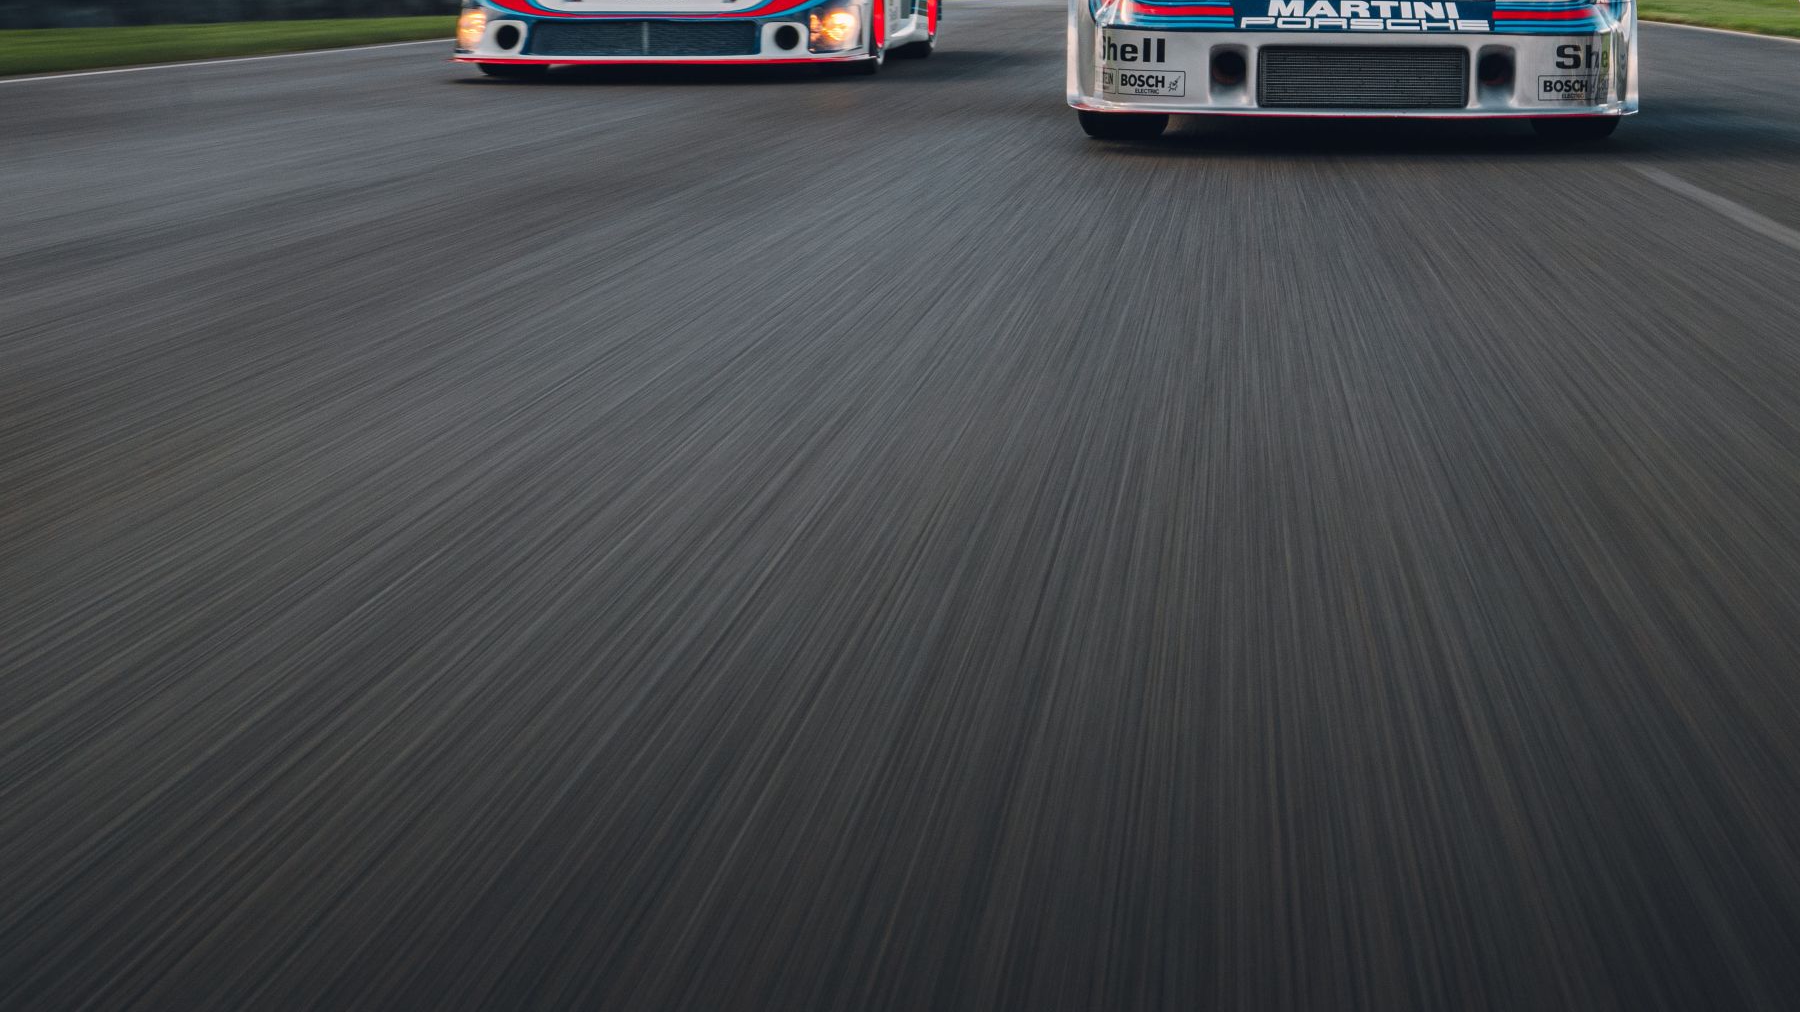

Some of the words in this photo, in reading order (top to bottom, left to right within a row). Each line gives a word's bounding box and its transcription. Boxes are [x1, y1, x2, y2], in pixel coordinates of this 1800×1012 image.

[1267, 0, 1460, 19] MARTINI
[1240, 16, 1490, 32] PORSCHE
[1120, 73, 1166, 89] BOSCH
[1543, 80, 1589, 93] BOSCH
